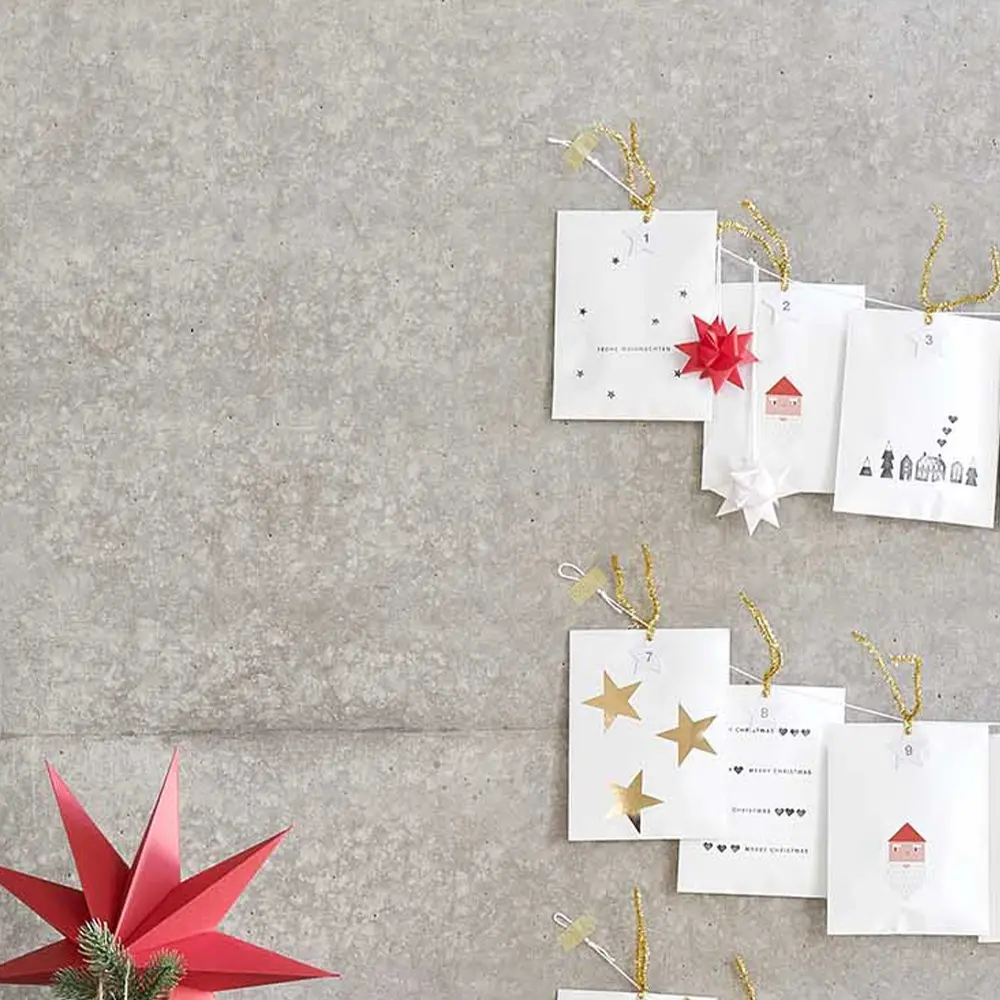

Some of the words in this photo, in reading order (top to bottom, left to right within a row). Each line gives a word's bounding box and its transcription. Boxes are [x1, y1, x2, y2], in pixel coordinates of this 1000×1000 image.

[643, 233, 650, 244] 1
[781, 301, 791, 311] 2
[925, 334, 934, 345] 3
[645, 651, 654, 662] 7
[759, 707, 769, 719] 8
[904, 745, 914, 757] 9
